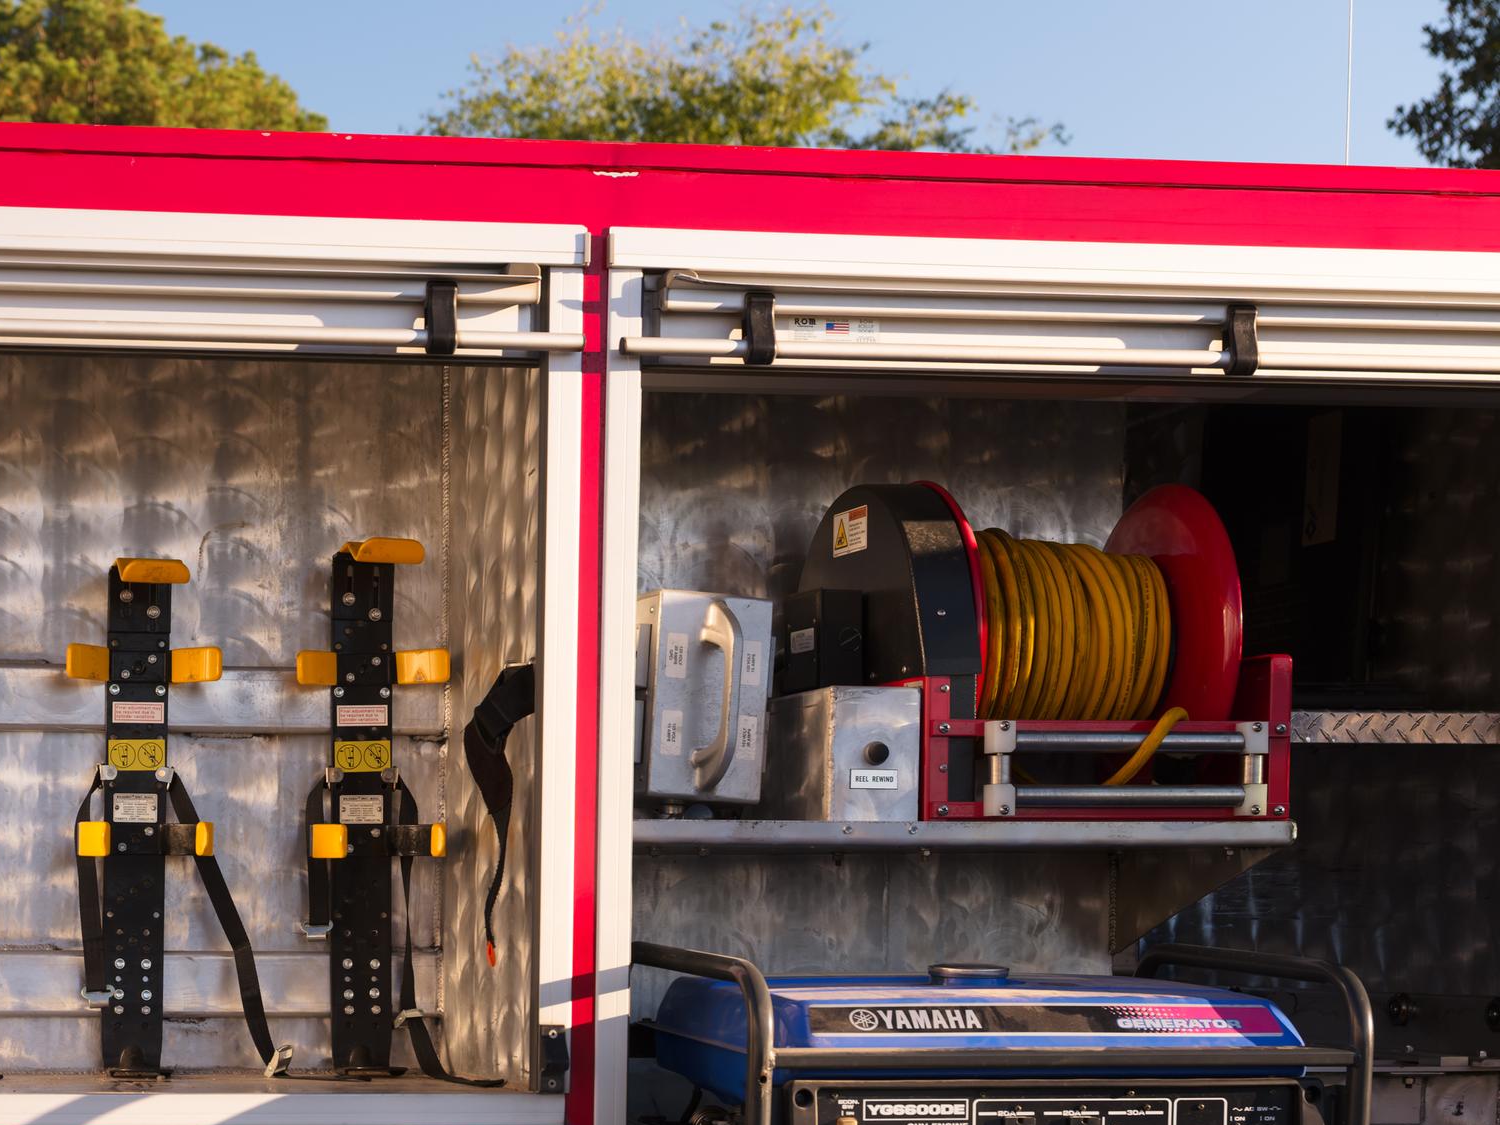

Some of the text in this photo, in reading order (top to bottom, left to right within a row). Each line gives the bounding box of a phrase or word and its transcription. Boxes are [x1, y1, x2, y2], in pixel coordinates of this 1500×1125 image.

[877, 1009, 983, 1030] YAMAHA
[1117, 1018, 1242, 1029] GENERATOR
[866, 1103, 966, 1116] YG6600DE
